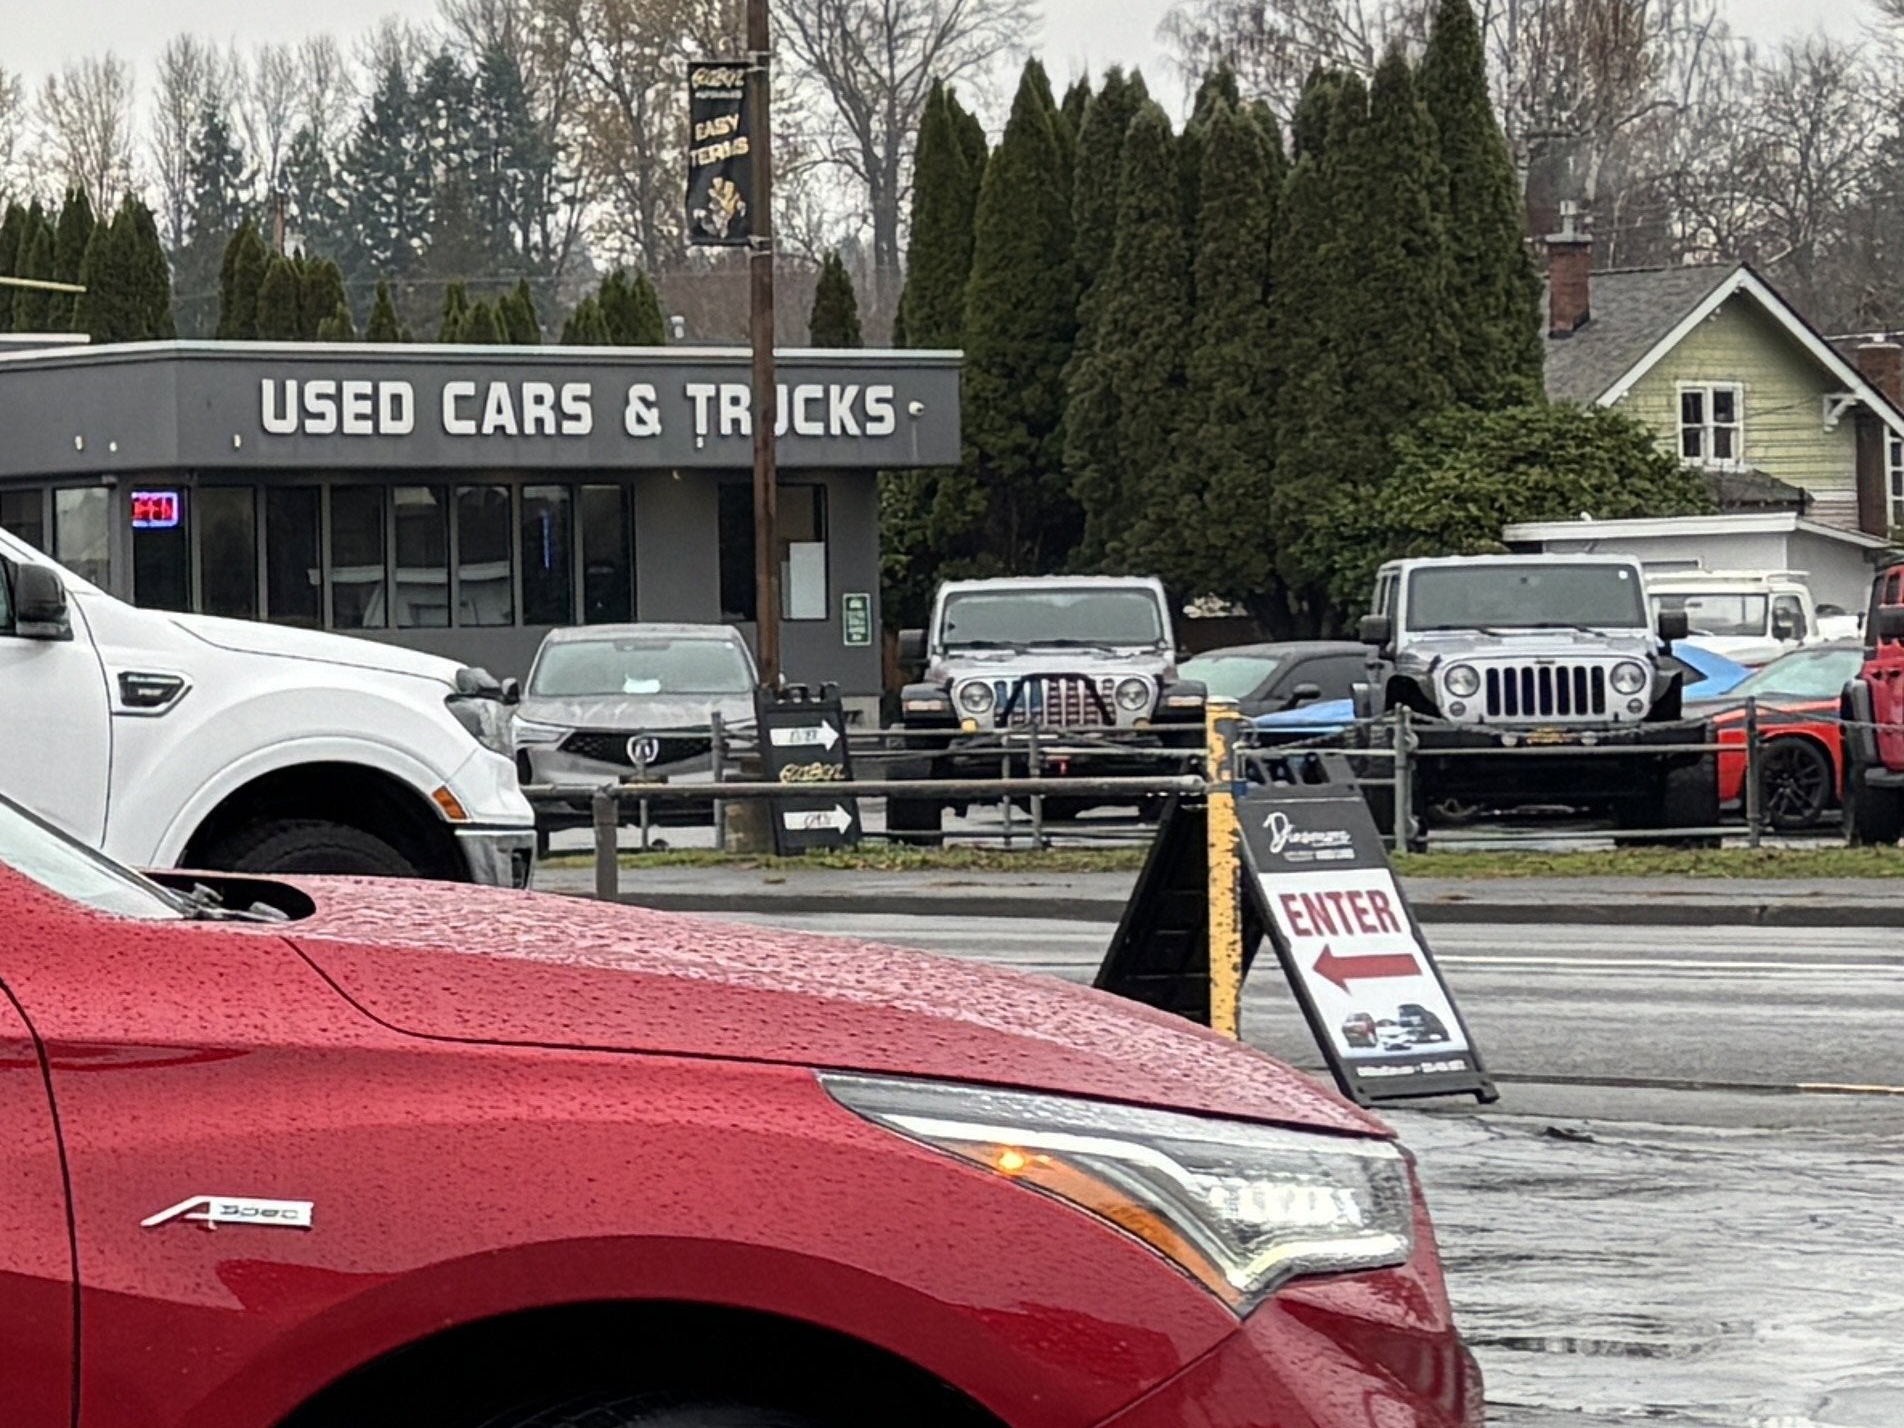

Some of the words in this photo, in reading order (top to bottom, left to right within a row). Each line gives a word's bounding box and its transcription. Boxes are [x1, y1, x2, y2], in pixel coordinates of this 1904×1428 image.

[260, 377, 416, 436] USED
[441, 380, 594, 436] CARS
[624, 382, 663, 437] &
[1278, 889, 1402, 937] ENTER
